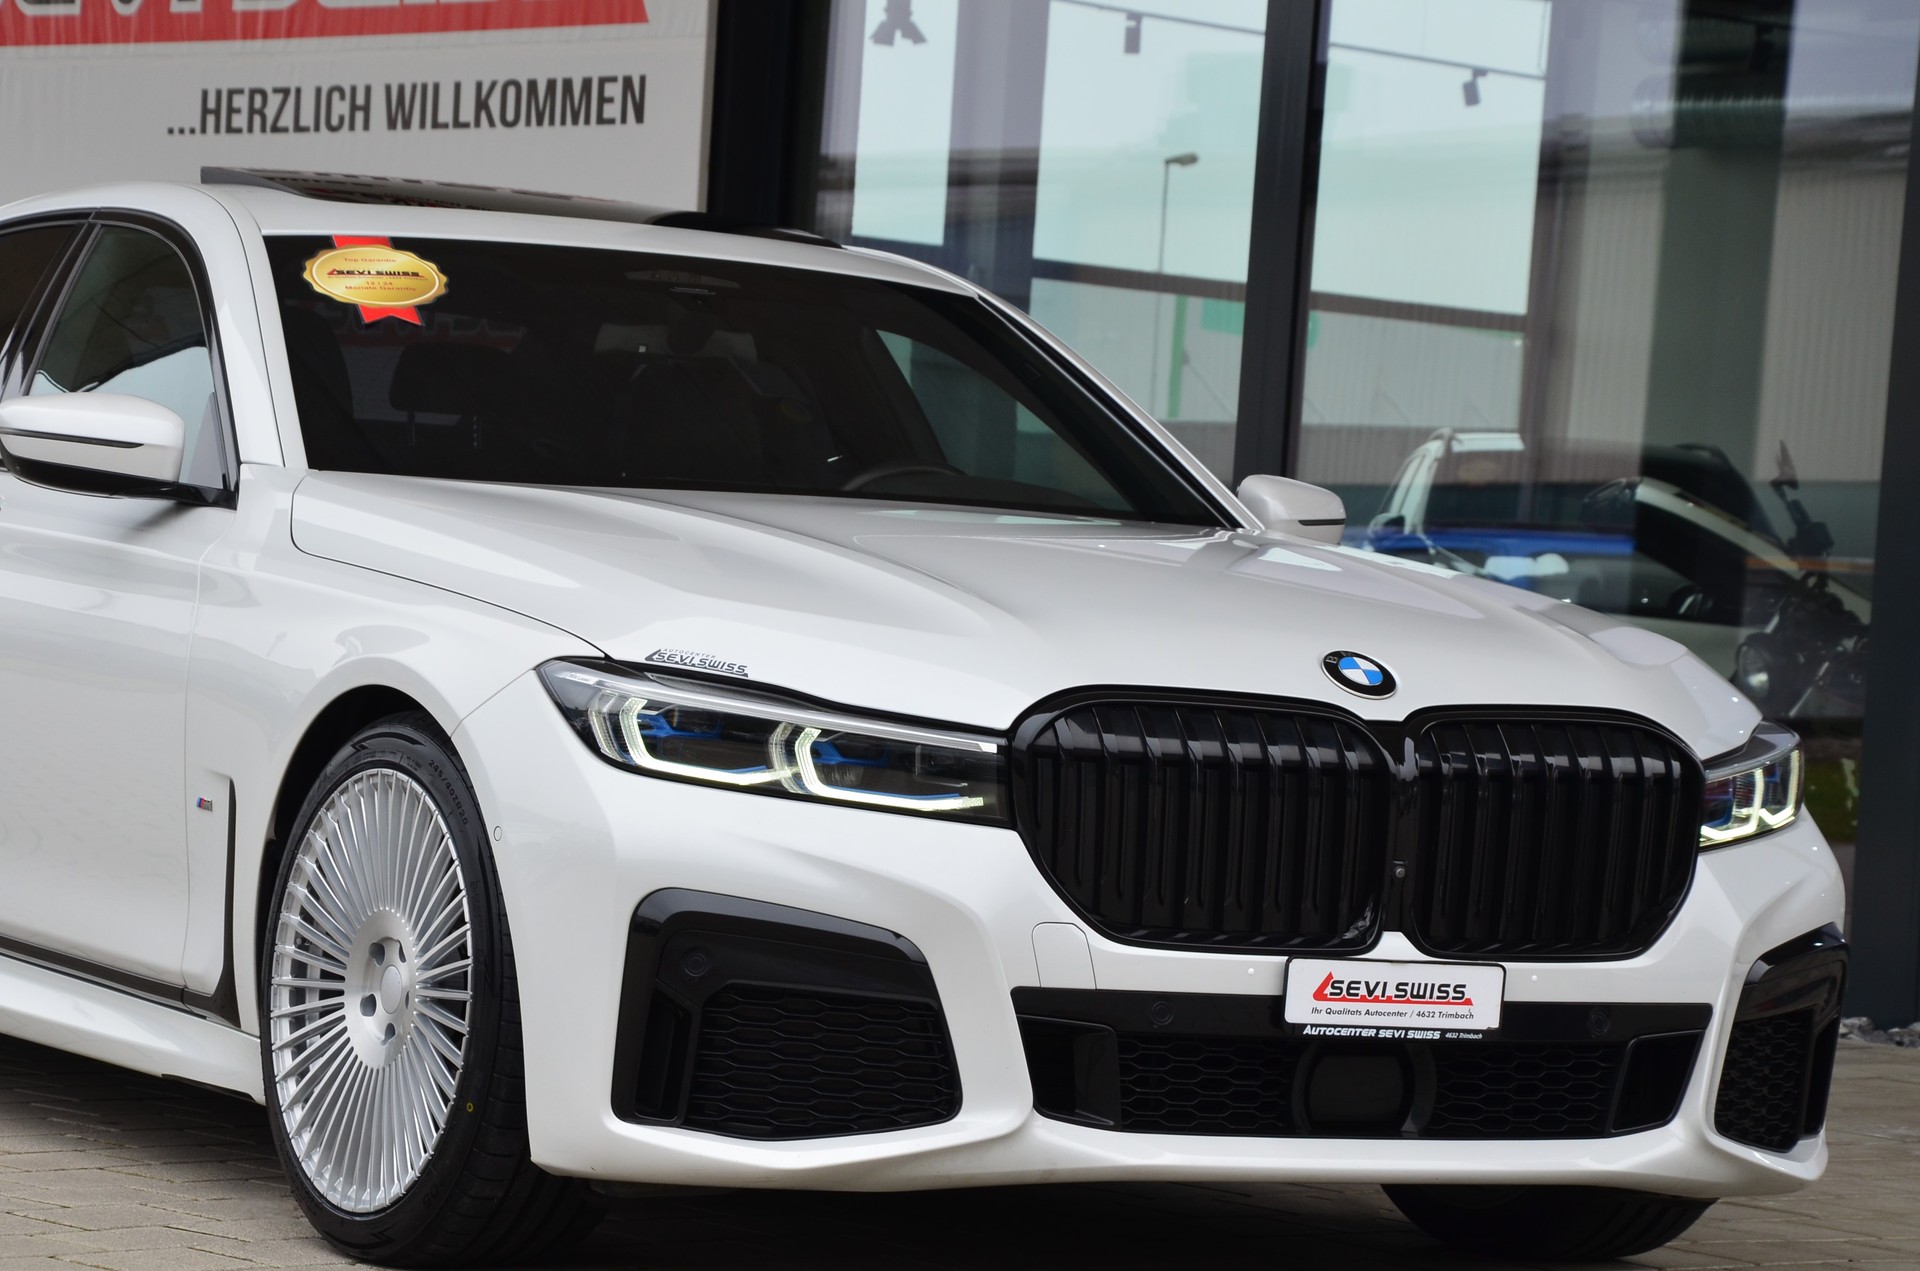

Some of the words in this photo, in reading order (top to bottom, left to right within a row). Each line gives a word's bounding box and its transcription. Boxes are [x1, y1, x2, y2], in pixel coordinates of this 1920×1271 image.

[167, 84, 372, 135] ...HERZLICH
[384, 74, 647, 131] WILLKOMMEN
[663, 648, 717, 659] AUTOCENTER
[697, 658, 748, 674] SWISS
[1329, 979, 1388, 998] SEVI
[1394, 982, 1467, 1001] SWISS
[1311, 1007, 1322, 1015] Ihr
[1325, 1007, 1362, 1017] Qualitats
[1364, 1008, 1408, 1018] Autocenter
[1416, 1010, 1436, 1019] 4632
[1438, 1011, 1474, 1020] Trimbach
[1303, 1024, 1376, 1037] AUTOCENTER
[1378, 1029, 1405, 1039] SEVI
[1407, 1030, 1441, 1040] SWISS
